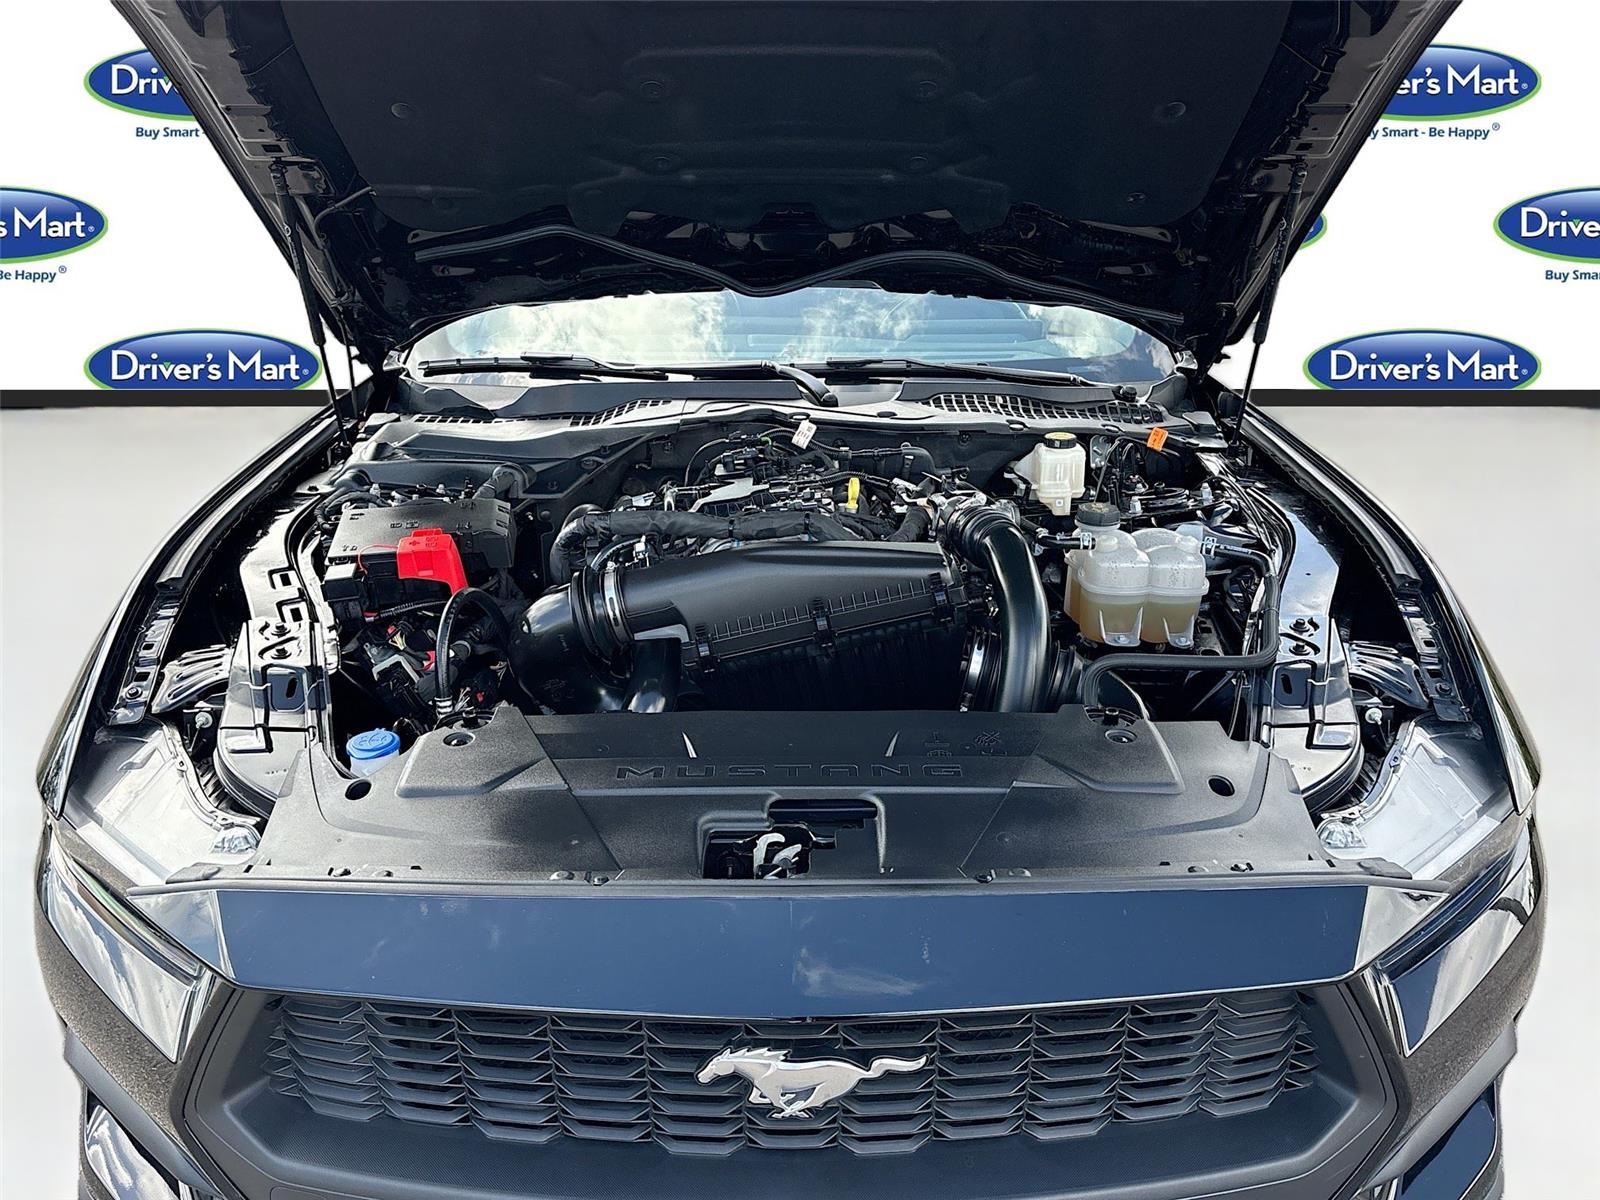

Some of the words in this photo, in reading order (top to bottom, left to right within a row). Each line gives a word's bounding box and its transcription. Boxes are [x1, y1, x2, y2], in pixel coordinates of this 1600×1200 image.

[111, 64, 179, 94] Driv
[136, 127, 160, 140] Buy
[163, 127, 200, 138] Smart
[1382, 127, 1419, 138] Smart
[1429, 127, 1445, 138] Be
[1448, 127, 1491, 141] Happy
[1521, 207, 1600, 238] Drive
[15, 270, 57, 283] Happy
[1545, 270, 1570, 283] Buy
[1573, 270, 1600, 280] Sma
[111, 350, 222, 382] Driver's
[1330, 350, 1441, 382] Driver's
[616, 764, 963, 780] MUSTANG
